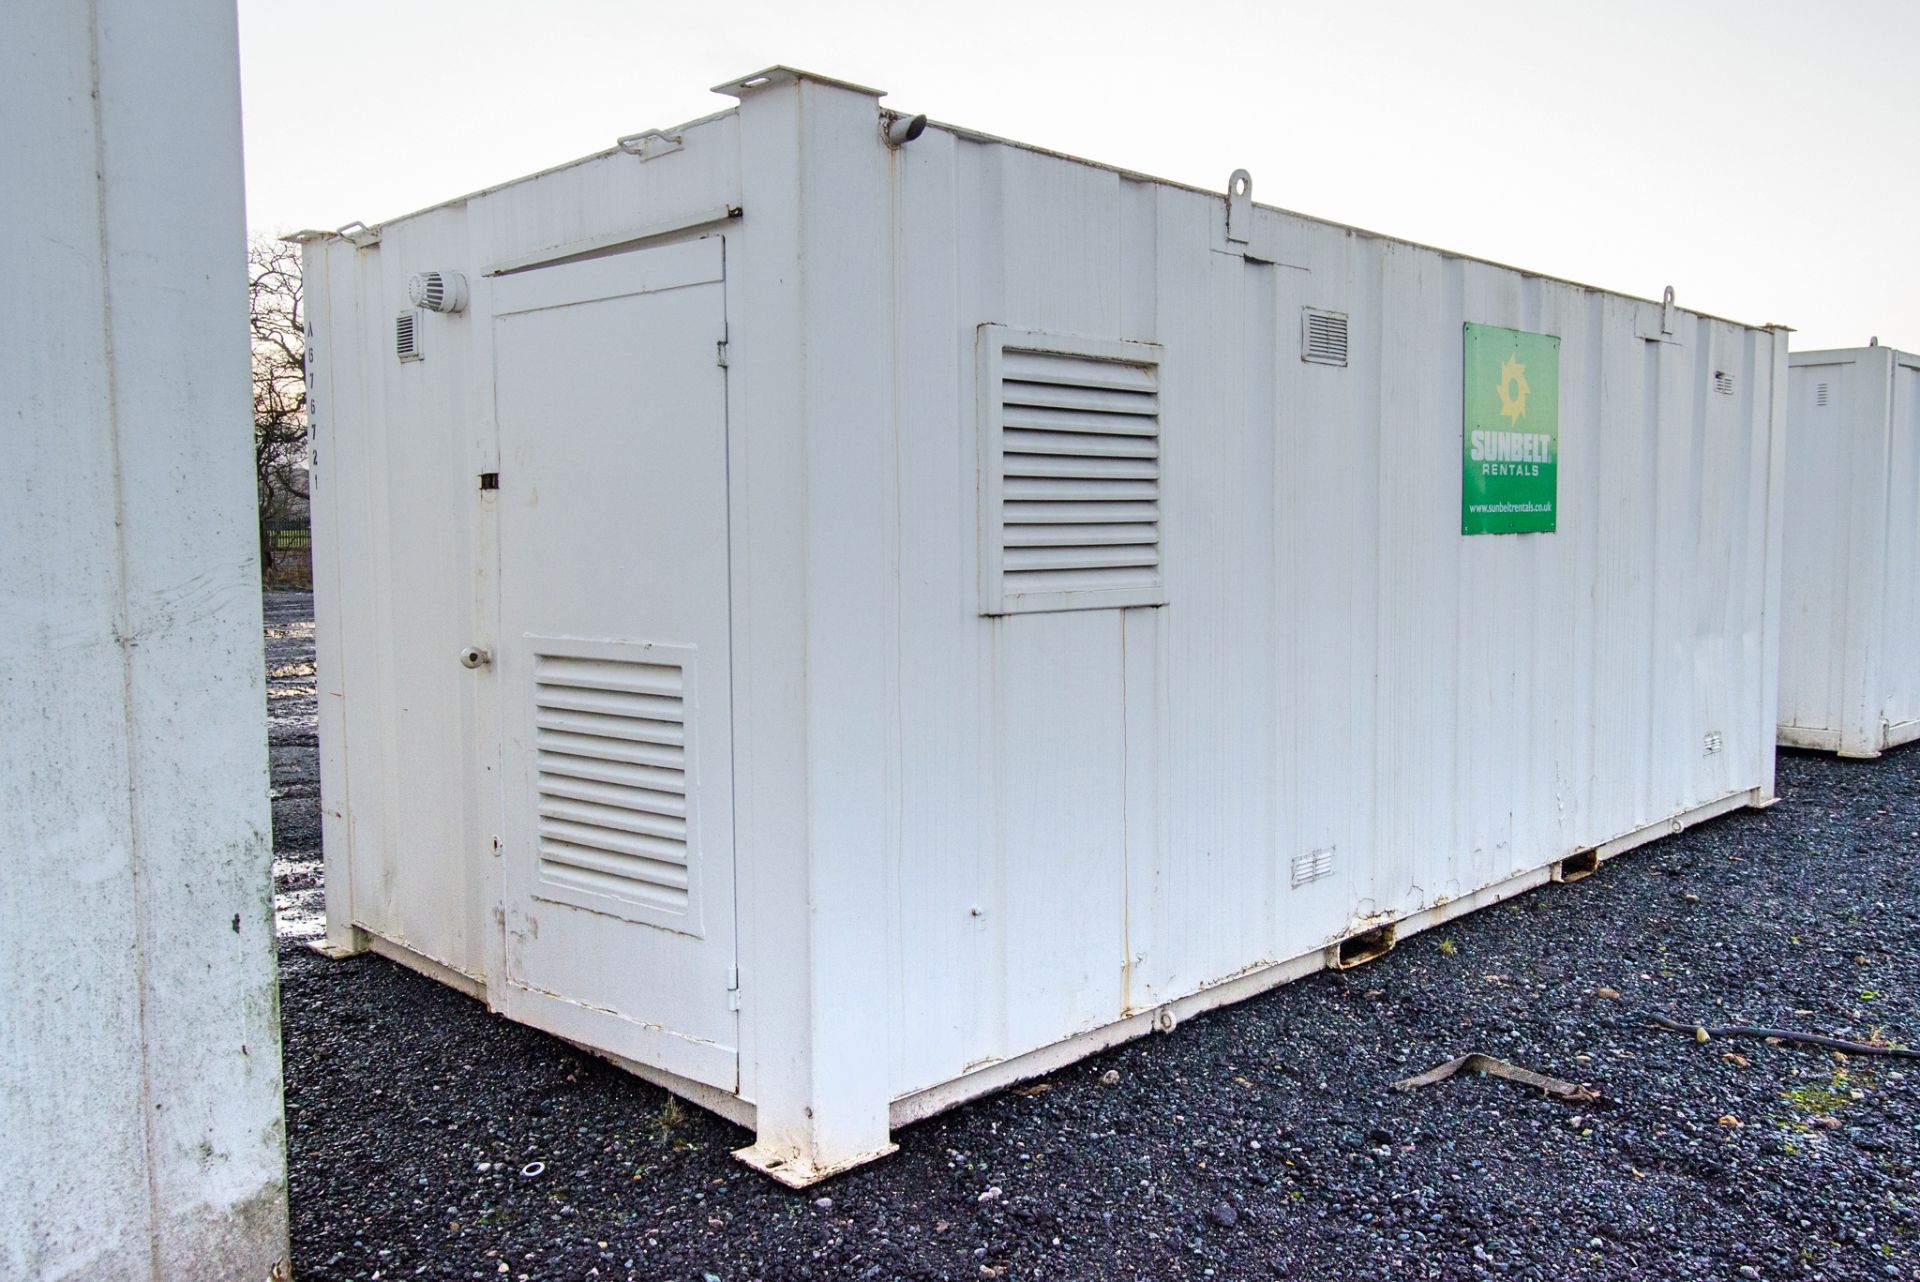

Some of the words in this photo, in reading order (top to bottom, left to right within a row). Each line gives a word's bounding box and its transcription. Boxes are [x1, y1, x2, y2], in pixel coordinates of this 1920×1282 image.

[1471, 430, 1551, 463] SUNBELT
[1482, 463, 1539, 476] RENTALS
[1469, 501, 1552, 512] www.sunbeltrentals.co.uk
